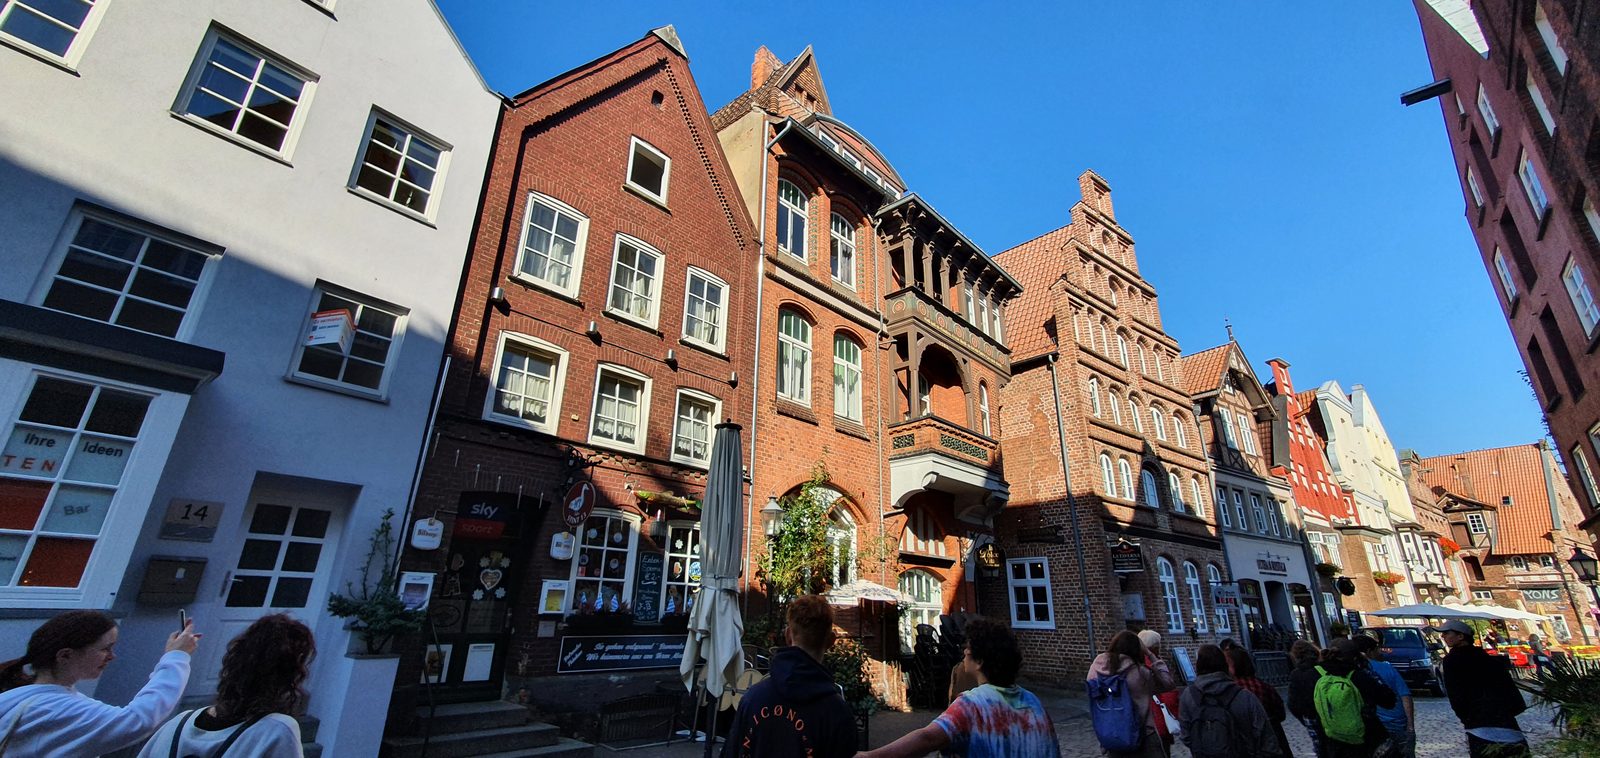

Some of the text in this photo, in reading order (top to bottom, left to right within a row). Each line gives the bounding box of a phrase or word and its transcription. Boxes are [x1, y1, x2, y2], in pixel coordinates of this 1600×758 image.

[24, 433, 123, 457] Ihre Ideen
[64, 504, 90, 516] Bar
[181, 503, 208, 521] 14
[470, 502, 499, 519] sky
[462, 523, 493, 535] sport
